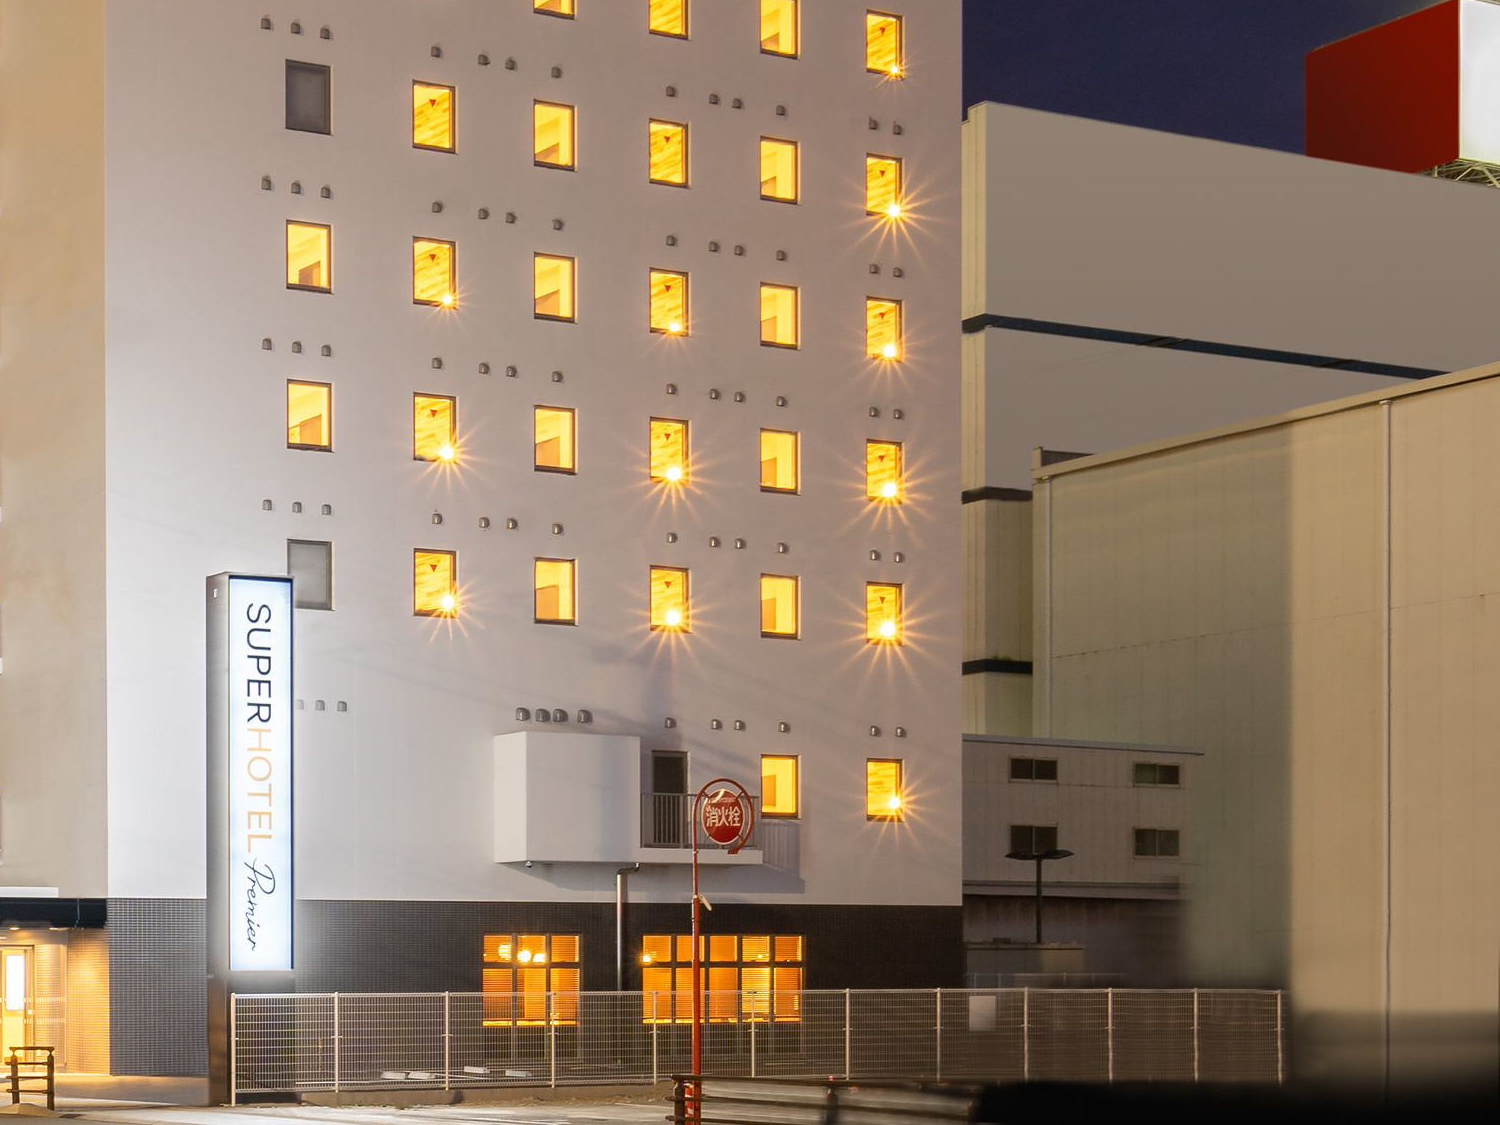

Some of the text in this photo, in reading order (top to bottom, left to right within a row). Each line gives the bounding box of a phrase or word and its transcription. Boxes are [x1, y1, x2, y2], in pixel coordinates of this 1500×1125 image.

[705, 806, 741, 827] 消火栓
[244, 857, 276, 951] Premier
